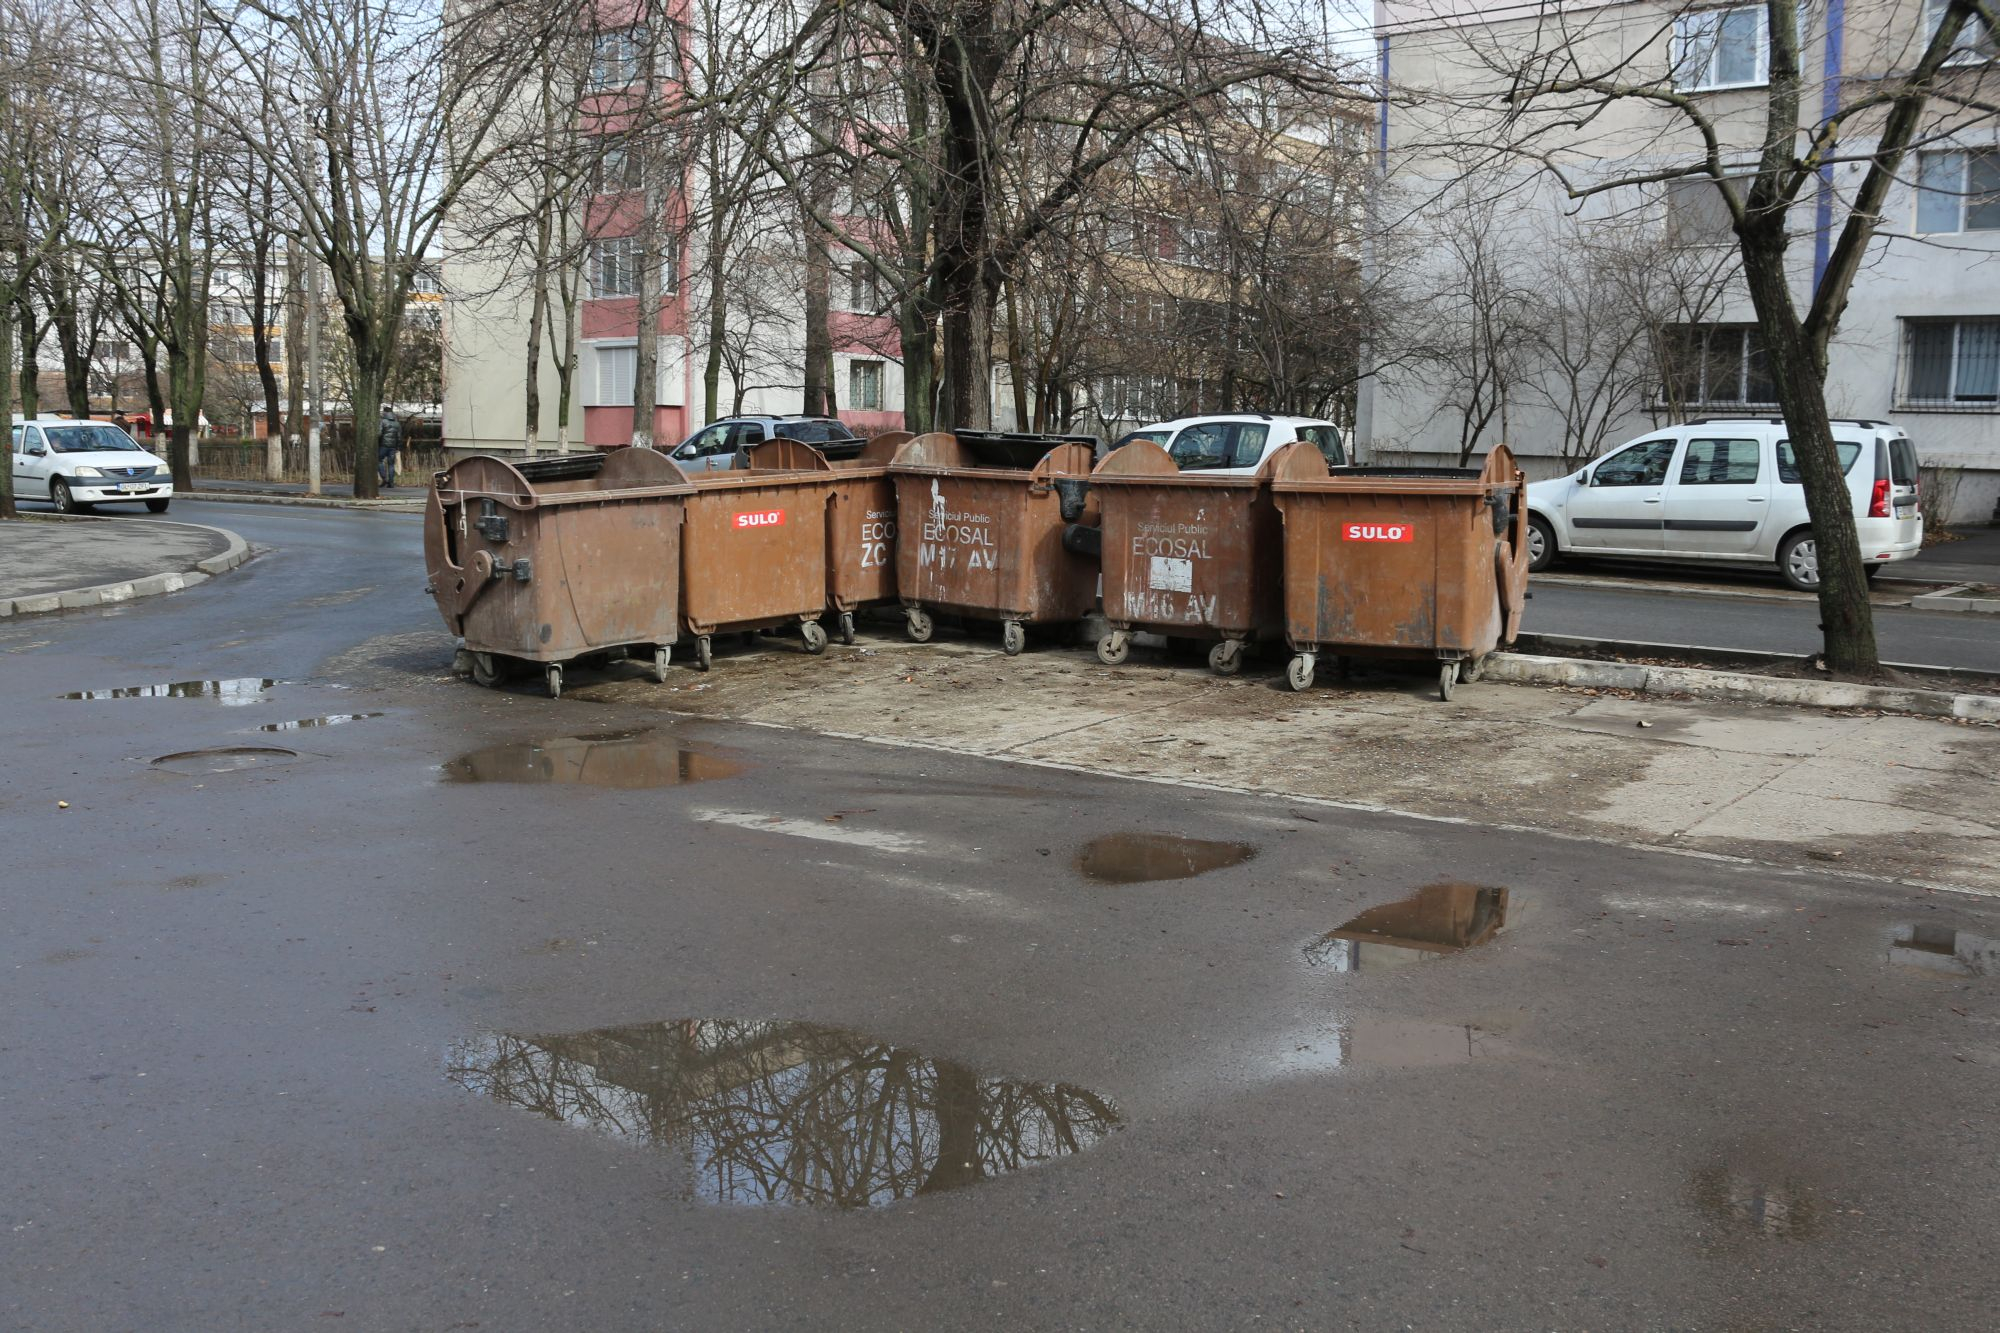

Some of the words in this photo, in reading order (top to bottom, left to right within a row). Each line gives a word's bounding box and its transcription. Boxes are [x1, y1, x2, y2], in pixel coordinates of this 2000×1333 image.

[738, 512, 779, 527] SULO
[963, 512, 991, 524] Public
[1177, 523, 1209, 535] Public
[924, 522, 994, 547] ECOSAL
[1348, 525, 1402, 540] SULO
[861, 542, 887, 568] ZC
[1132, 536, 1213, 559] ECOSAL
[967, 548, 998, 571] AV
[1184, 594, 1217, 622] AV
